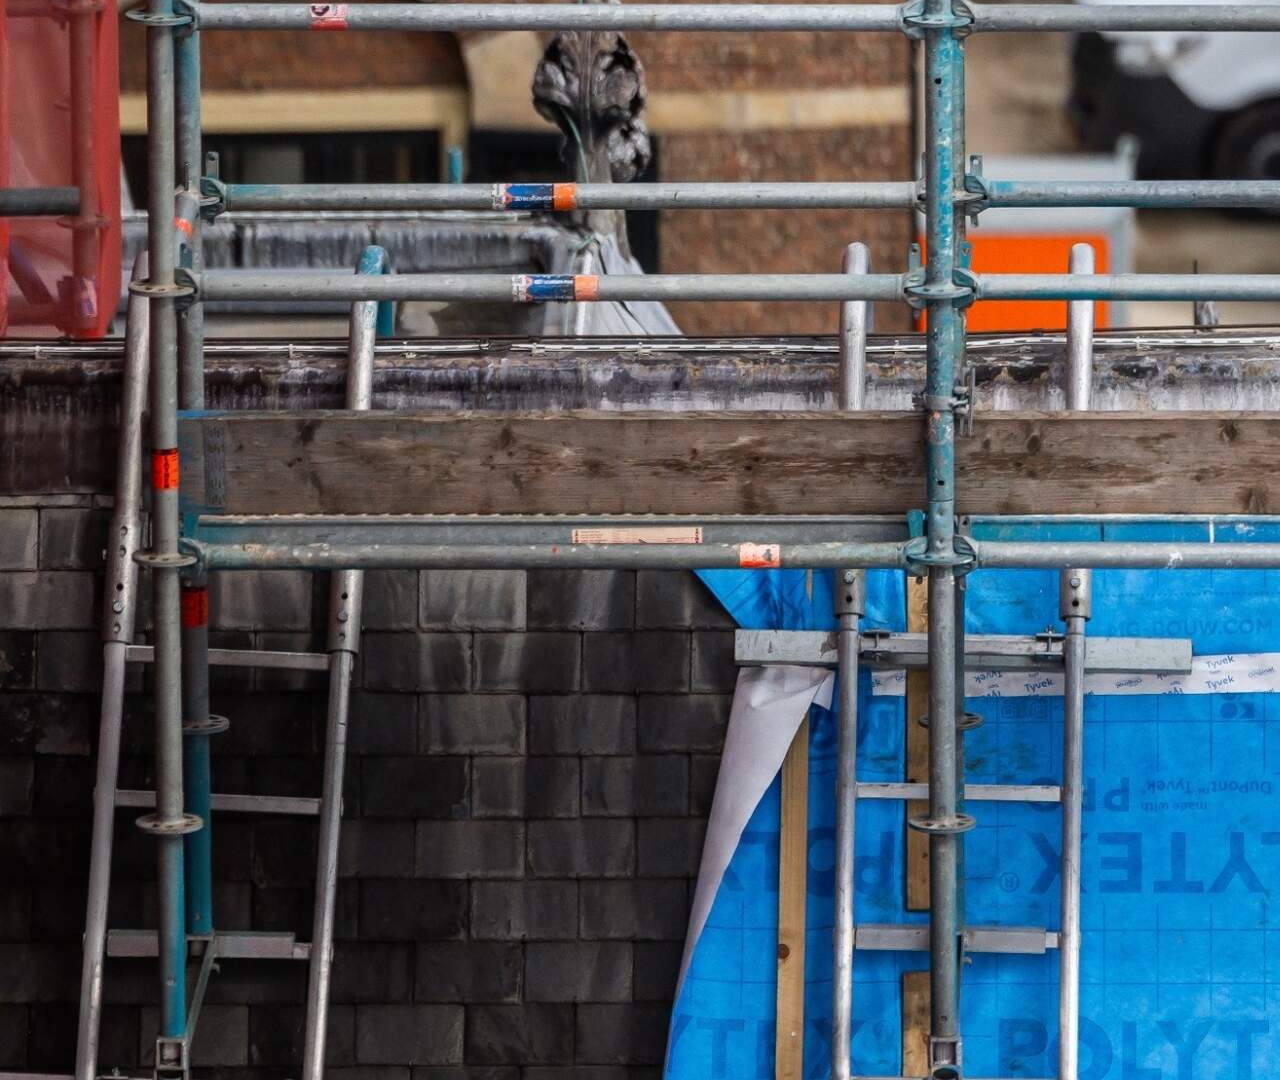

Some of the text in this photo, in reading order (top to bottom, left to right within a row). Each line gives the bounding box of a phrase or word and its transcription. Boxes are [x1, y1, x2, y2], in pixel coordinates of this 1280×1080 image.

[1206, 655, 1235, 669] Tyvek
[1023, 679, 1055, 694] Tyvek
[1205, 675, 1234, 690] Tyvek
[1140, 801, 1208, 812] made with
